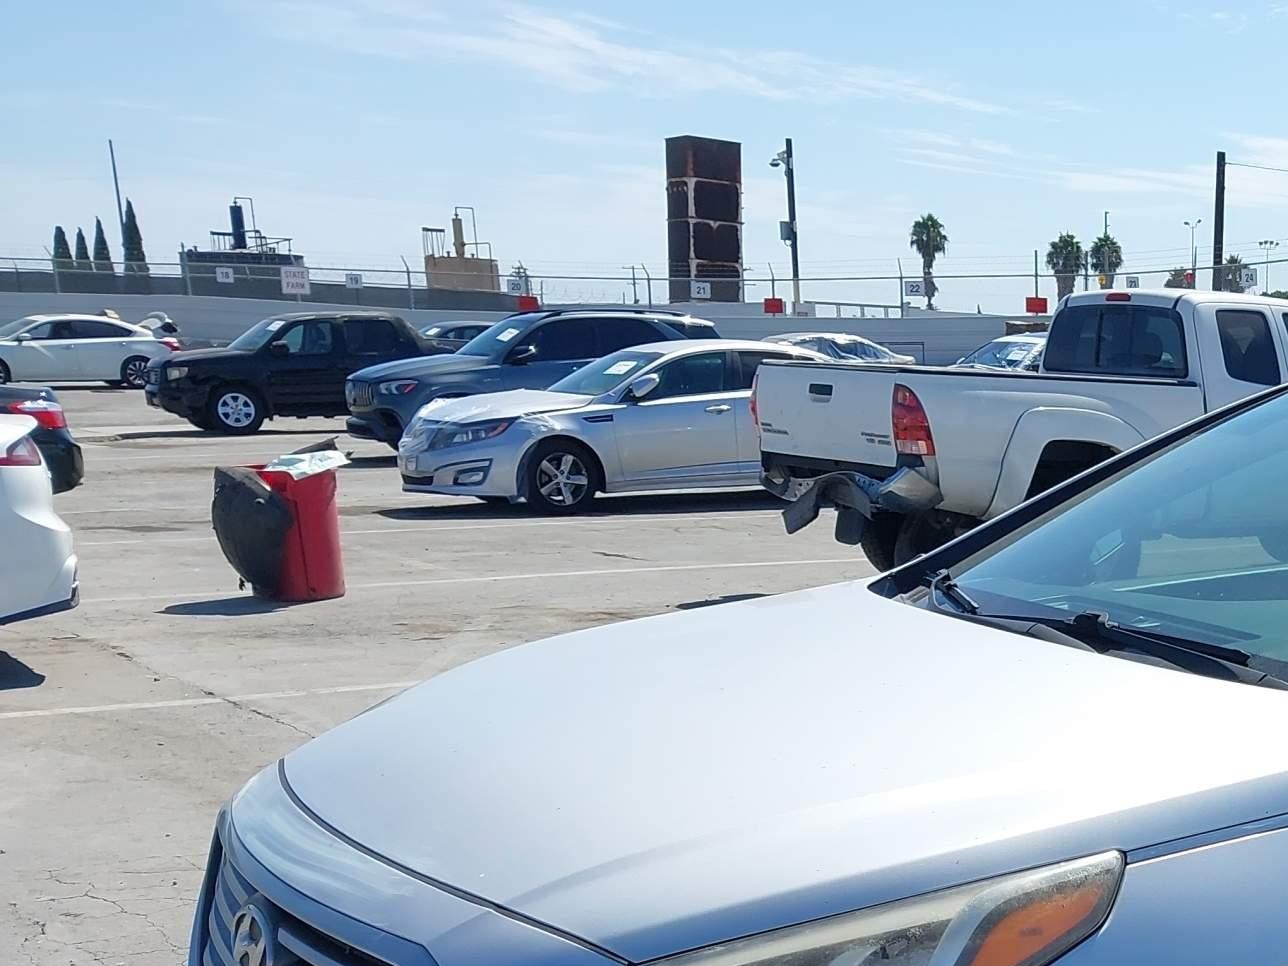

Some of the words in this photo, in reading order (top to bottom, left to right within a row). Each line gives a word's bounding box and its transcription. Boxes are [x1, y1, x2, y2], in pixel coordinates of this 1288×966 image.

[284, 271, 305, 279] STATE
[1245, 273, 1254, 282] 24
[350, 277, 359, 286] 19
[511, 283, 522, 291] 20
[696, 286, 706, 295] 21
[910, 284, 921, 293] 22
